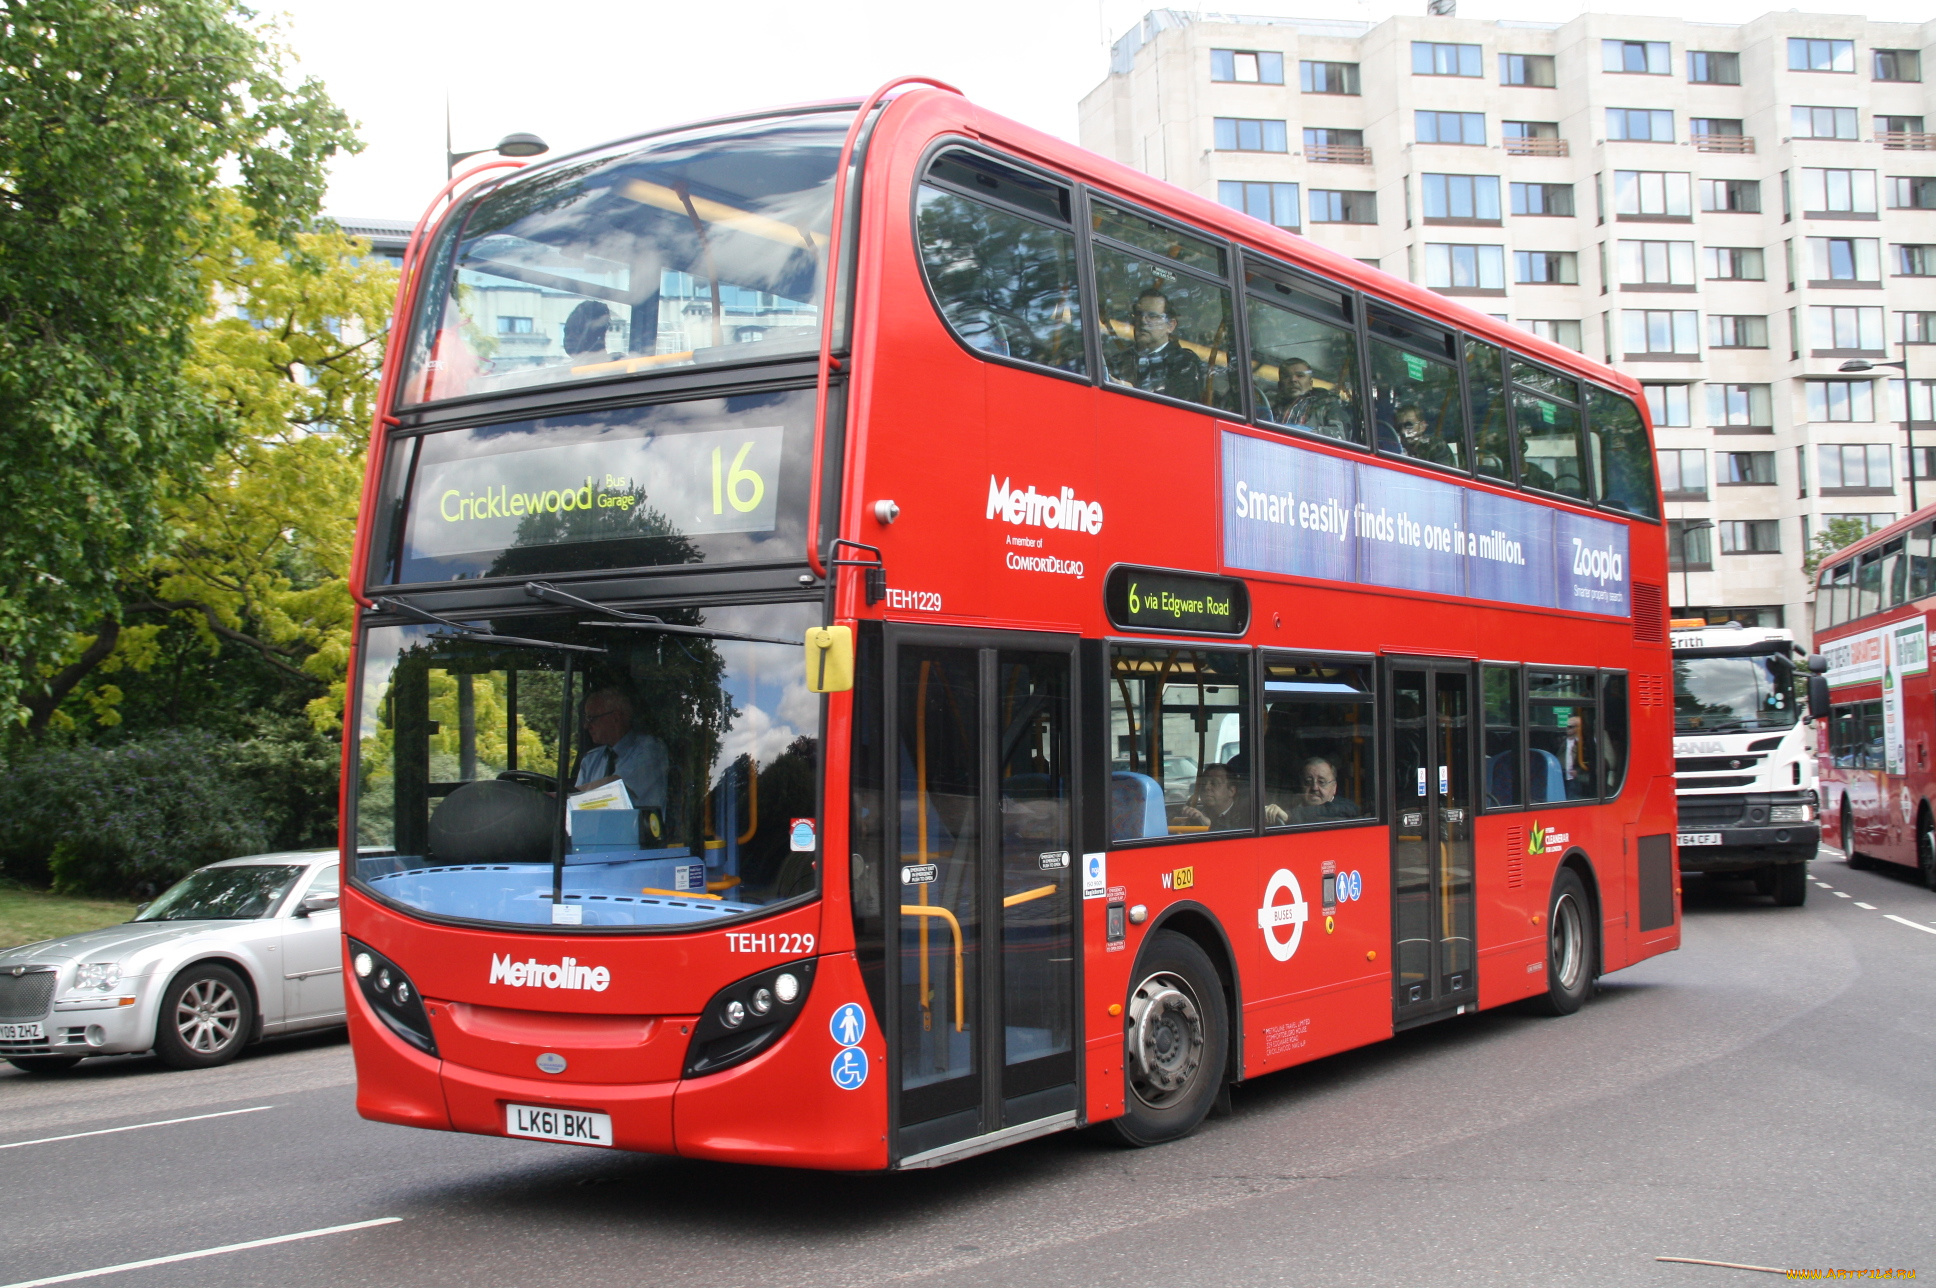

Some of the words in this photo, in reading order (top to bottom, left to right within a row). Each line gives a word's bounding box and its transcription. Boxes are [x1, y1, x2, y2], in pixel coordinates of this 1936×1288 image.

[605, 474, 626, 488] Bus
[711, 441, 765, 515] 16
[440, 475, 593, 523] Cricklewood
[597, 493, 635, 511] Garage
[986, 474, 1103, 535] Metroline
[1236, 480, 1295, 526] Smart
[1299, 498, 1349, 542] easily
[1354, 502, 1395, 543] finds
[1397, 512, 1421, 547] the
[1424, 524, 1451, 553] one
[1453, 522, 1465, 555] in
[1468, 532, 1477, 557] a
[1480, 529, 1525, 565] million.
[1006, 534, 1011, 545] A
[1012, 536, 1036, 548] member
[1036, 538, 1043, 549] of
[1572, 537, 1622, 587] Zoopla
[885, 588, 942, 612] TEH1229
[1129, 583, 1140, 614] 6
[1144, 592, 1158, 610] via
[1161, 591, 1204, 618] Edgware
[1206, 596, 1230, 616] Road
[1161, 872, 1173, 889] W
[1176, 869, 1192, 886] 620
[1274, 908, 1293, 921] BUSES
[725, 933, 815, 953] TEH1229
[489, 952, 611, 992] Metroline
[18, 1024, 39, 1038] ZHZ
[517, 1109, 558, 1134] LK61
[564, 1114, 600, 1140] BKL
